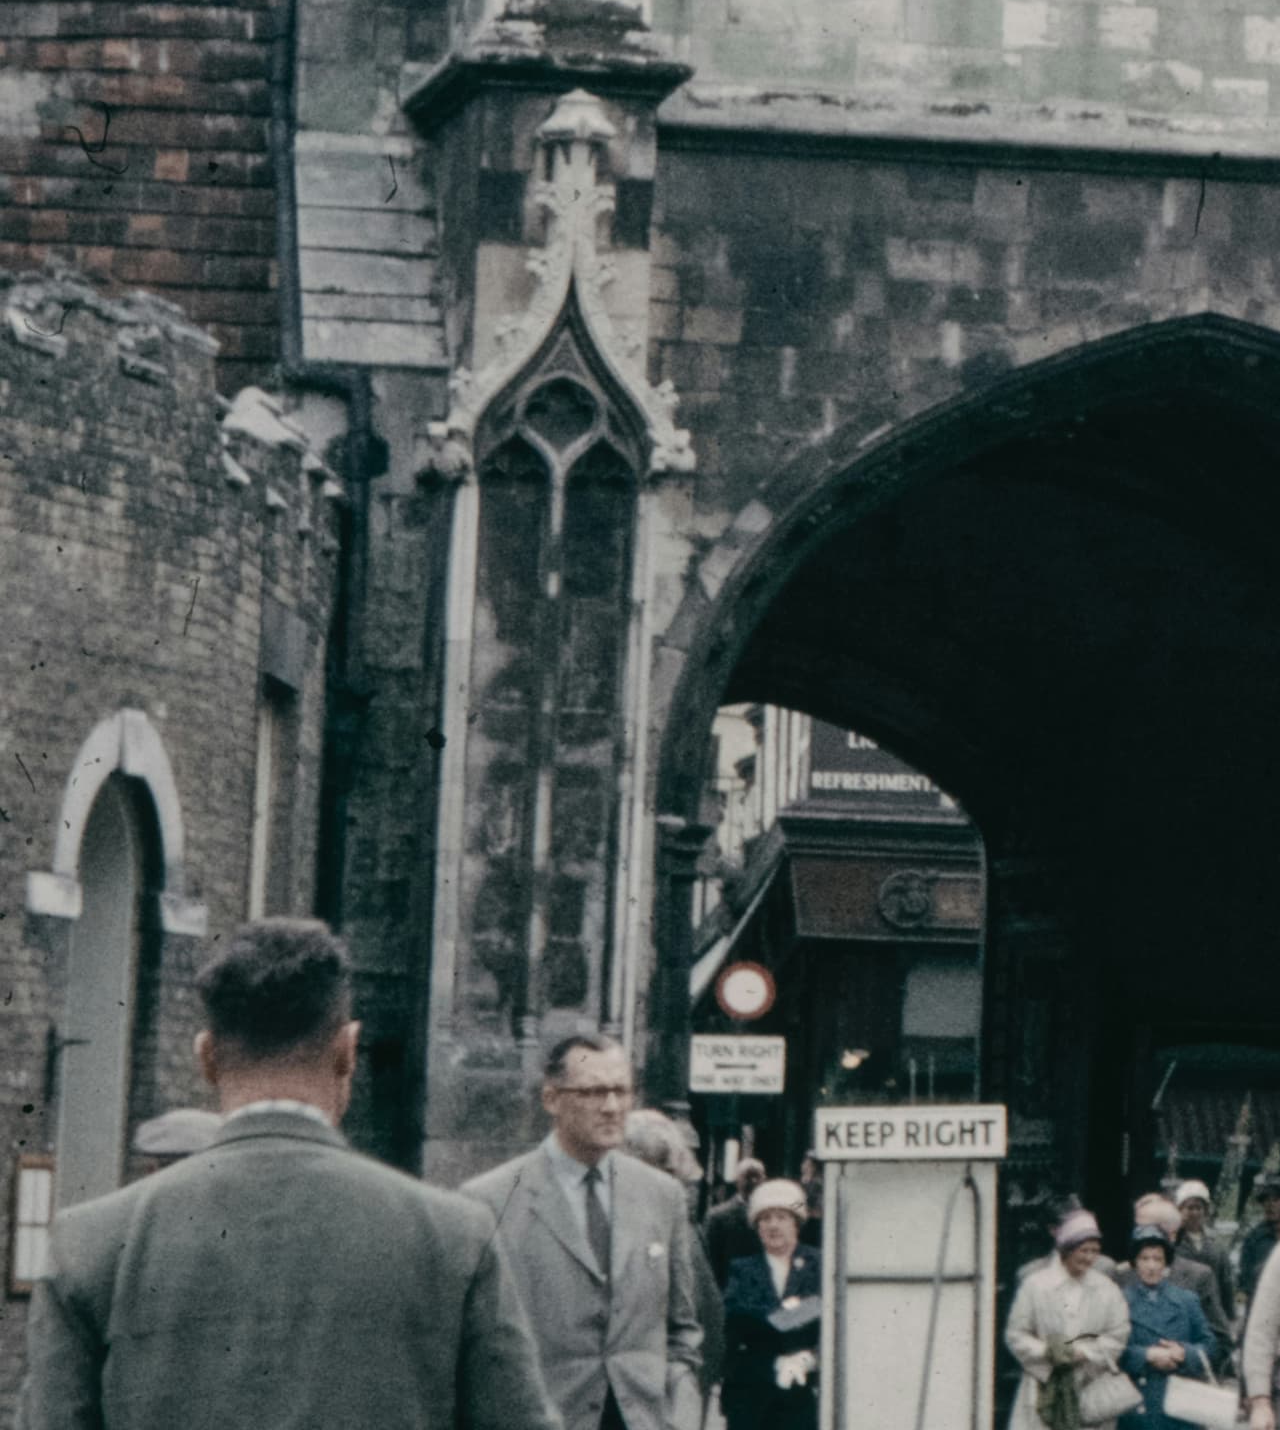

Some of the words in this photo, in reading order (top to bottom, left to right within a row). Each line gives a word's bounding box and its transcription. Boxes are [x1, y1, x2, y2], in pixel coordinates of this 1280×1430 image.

[811, 772, 939, 792] REFRESHMENT
[694, 1042, 733, 1058] TURN
[737, 1044, 782, 1059] RIGHT
[824, 1120, 895, 1148] KEEP
[904, 1119, 996, 1147] RIGHT
